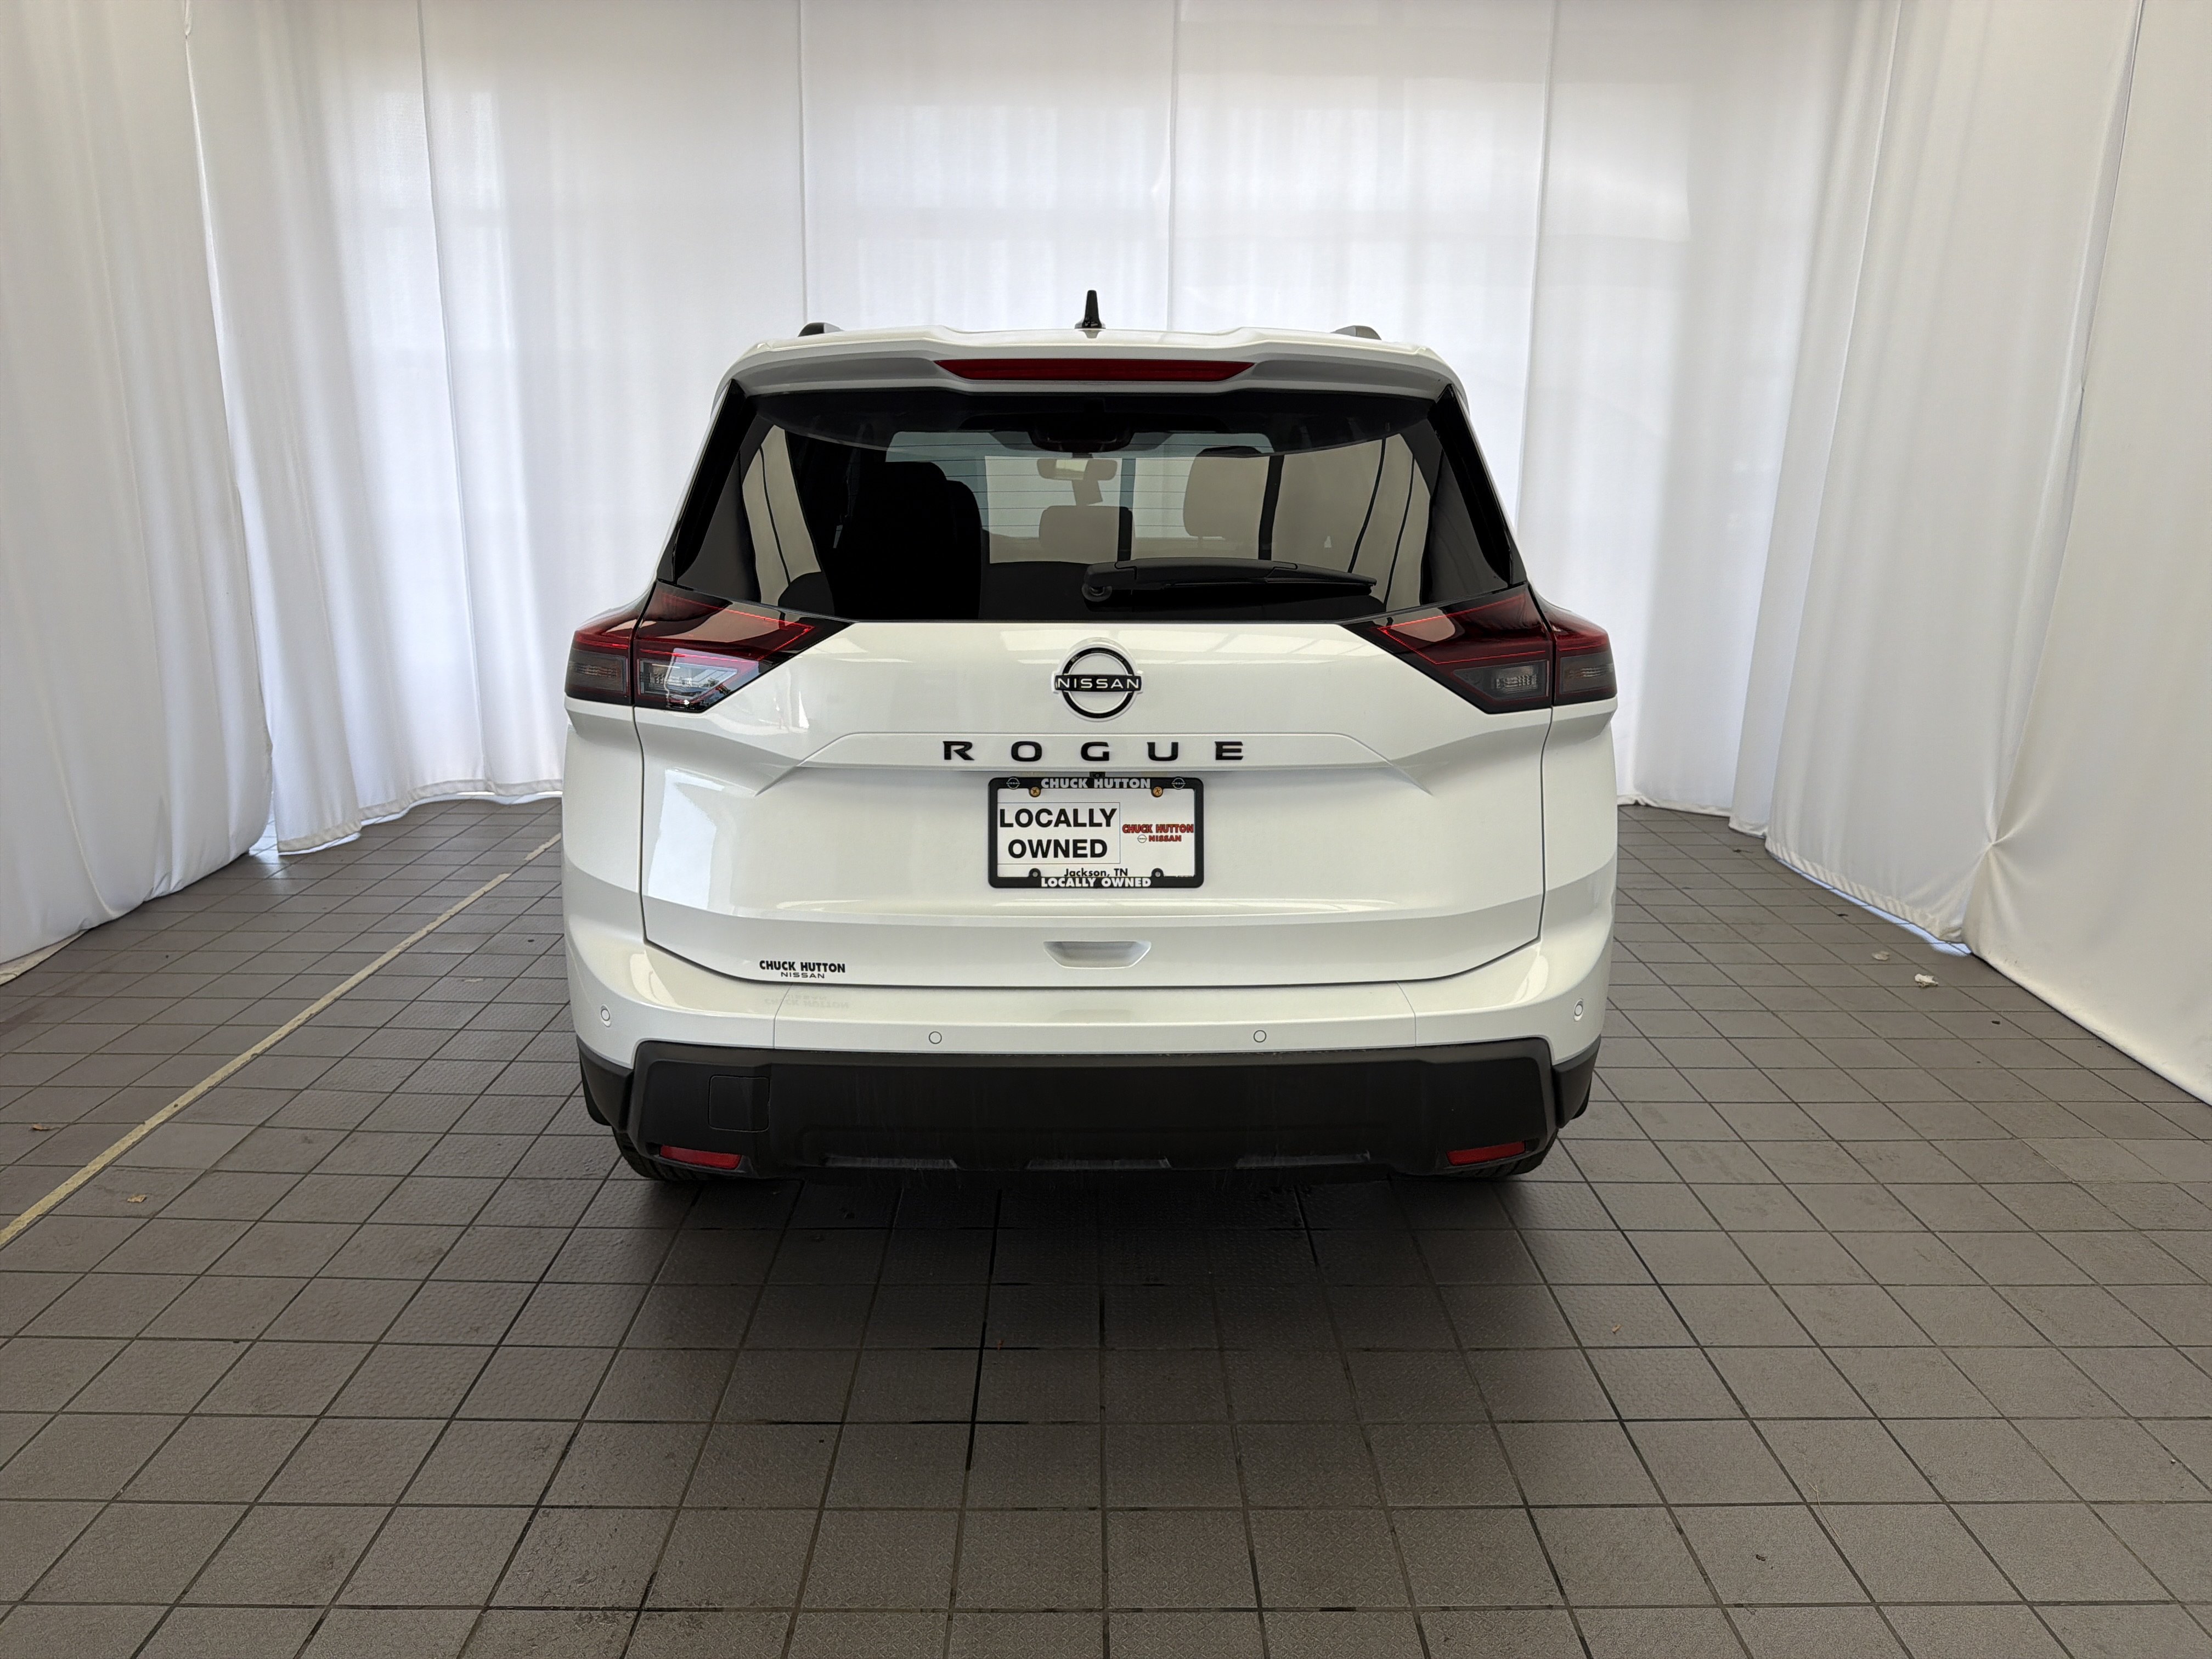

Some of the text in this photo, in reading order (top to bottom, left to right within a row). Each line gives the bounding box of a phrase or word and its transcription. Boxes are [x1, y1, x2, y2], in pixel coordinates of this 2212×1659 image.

[1058, 678, 1139, 689] NISSAN
[943, 741, 1244, 762] ROGUE
[1041, 778, 1150, 788] CHUCK HUTTON
[1000, 808, 1117, 828] LOCALLY
[1122, 824, 1194, 833] CHUCK HUTTON
[1008, 839, 1108, 859] OWNED
[1064, 868, 1128, 877] Jackson, TN
[1041, 878, 1152, 887] LOCALLY OWNED
[759, 960, 845, 973] CHUCK HUTTON
